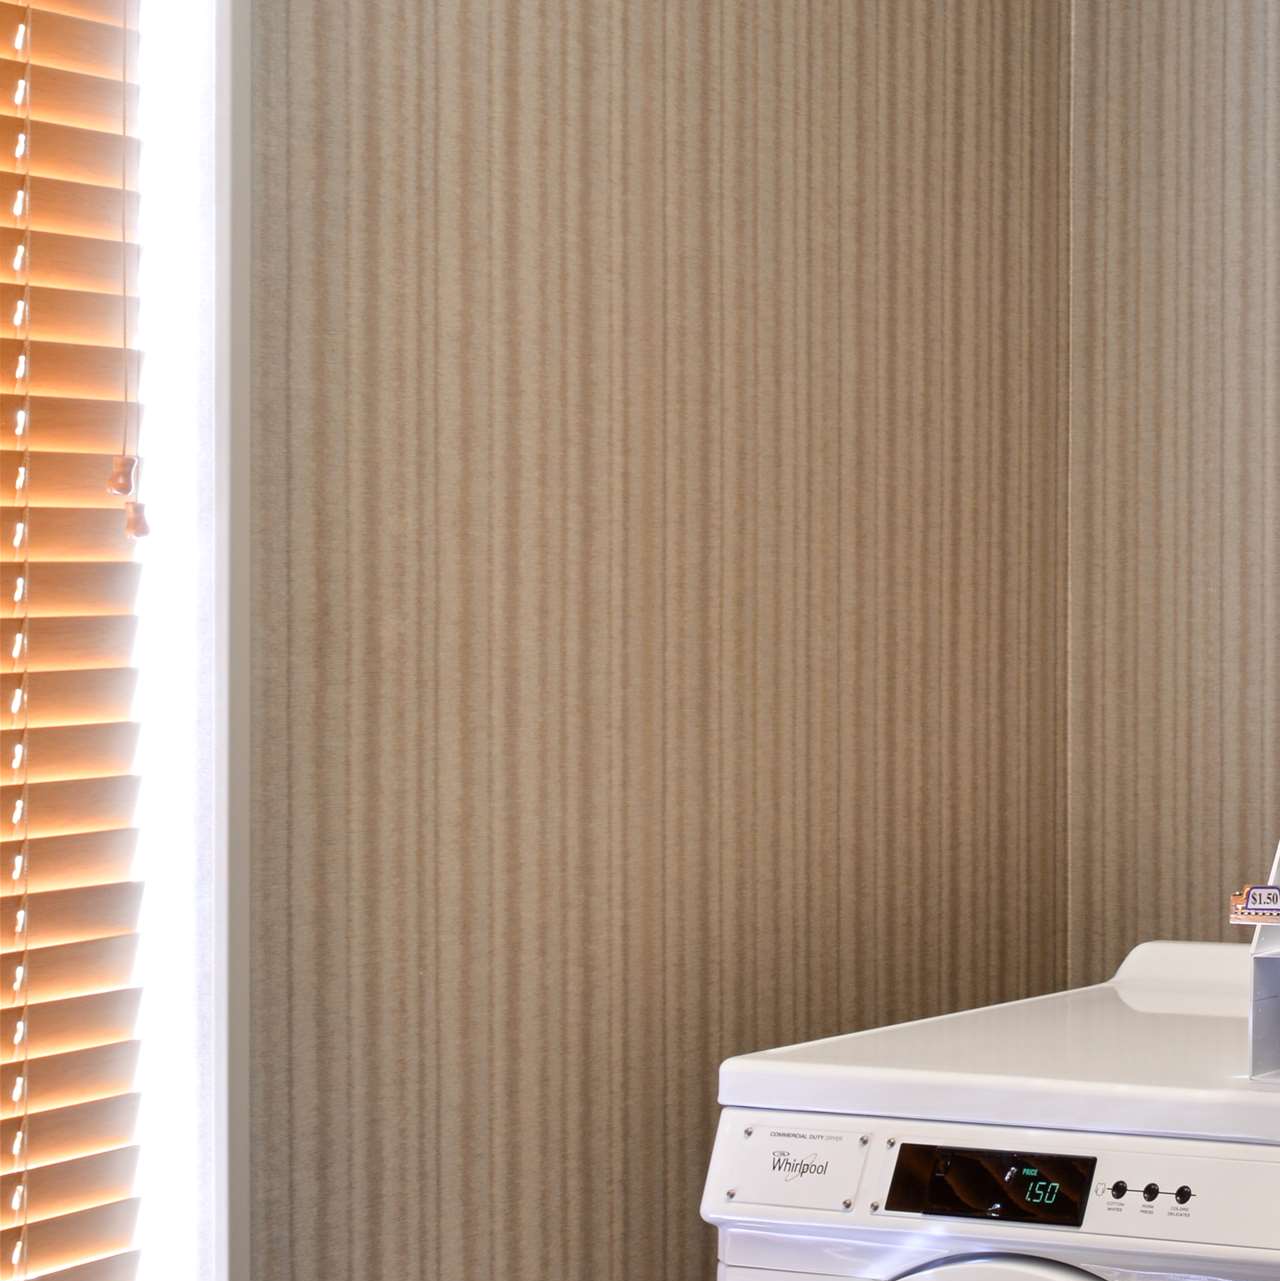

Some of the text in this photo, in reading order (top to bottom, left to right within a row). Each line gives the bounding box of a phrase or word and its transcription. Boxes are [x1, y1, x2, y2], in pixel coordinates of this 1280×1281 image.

[1251, 892, 1278, 905] $1.50
[771, 1157, 829, 1177] Whirlpool
[1025, 1181, 1060, 1204] 1.50
